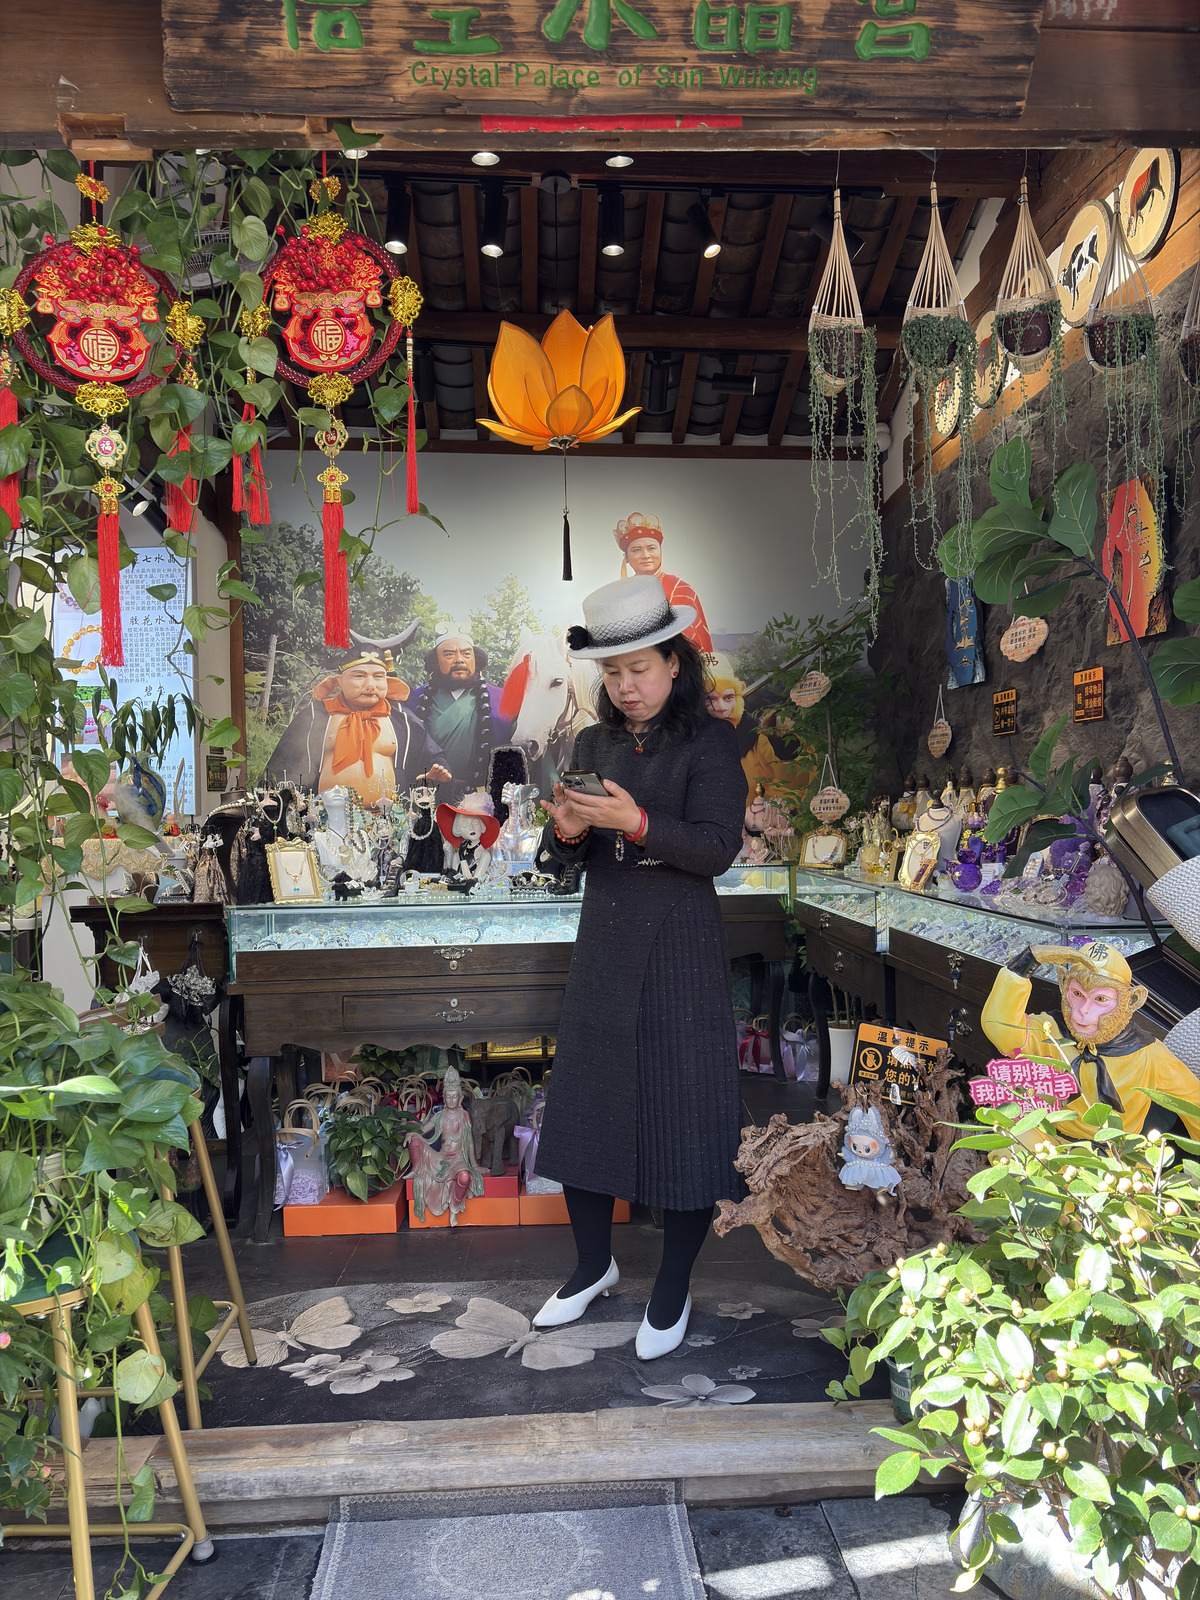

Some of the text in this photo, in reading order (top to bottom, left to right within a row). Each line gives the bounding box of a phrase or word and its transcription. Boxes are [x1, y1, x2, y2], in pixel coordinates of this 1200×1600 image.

[411, 61, 818, 95] Crystal Palace of Sun Wukong
[83, 330, 117, 362] 福
[313, 320, 342, 351] 福
[100, 440, 112, 452] 福
[1089, 943, 1109, 961] 佛
[877, 1030, 930, 1052] 温馨提示
[884, 1068, 925, 1087] 您的小
[992, 1062, 1052, 1083] 请别摸
